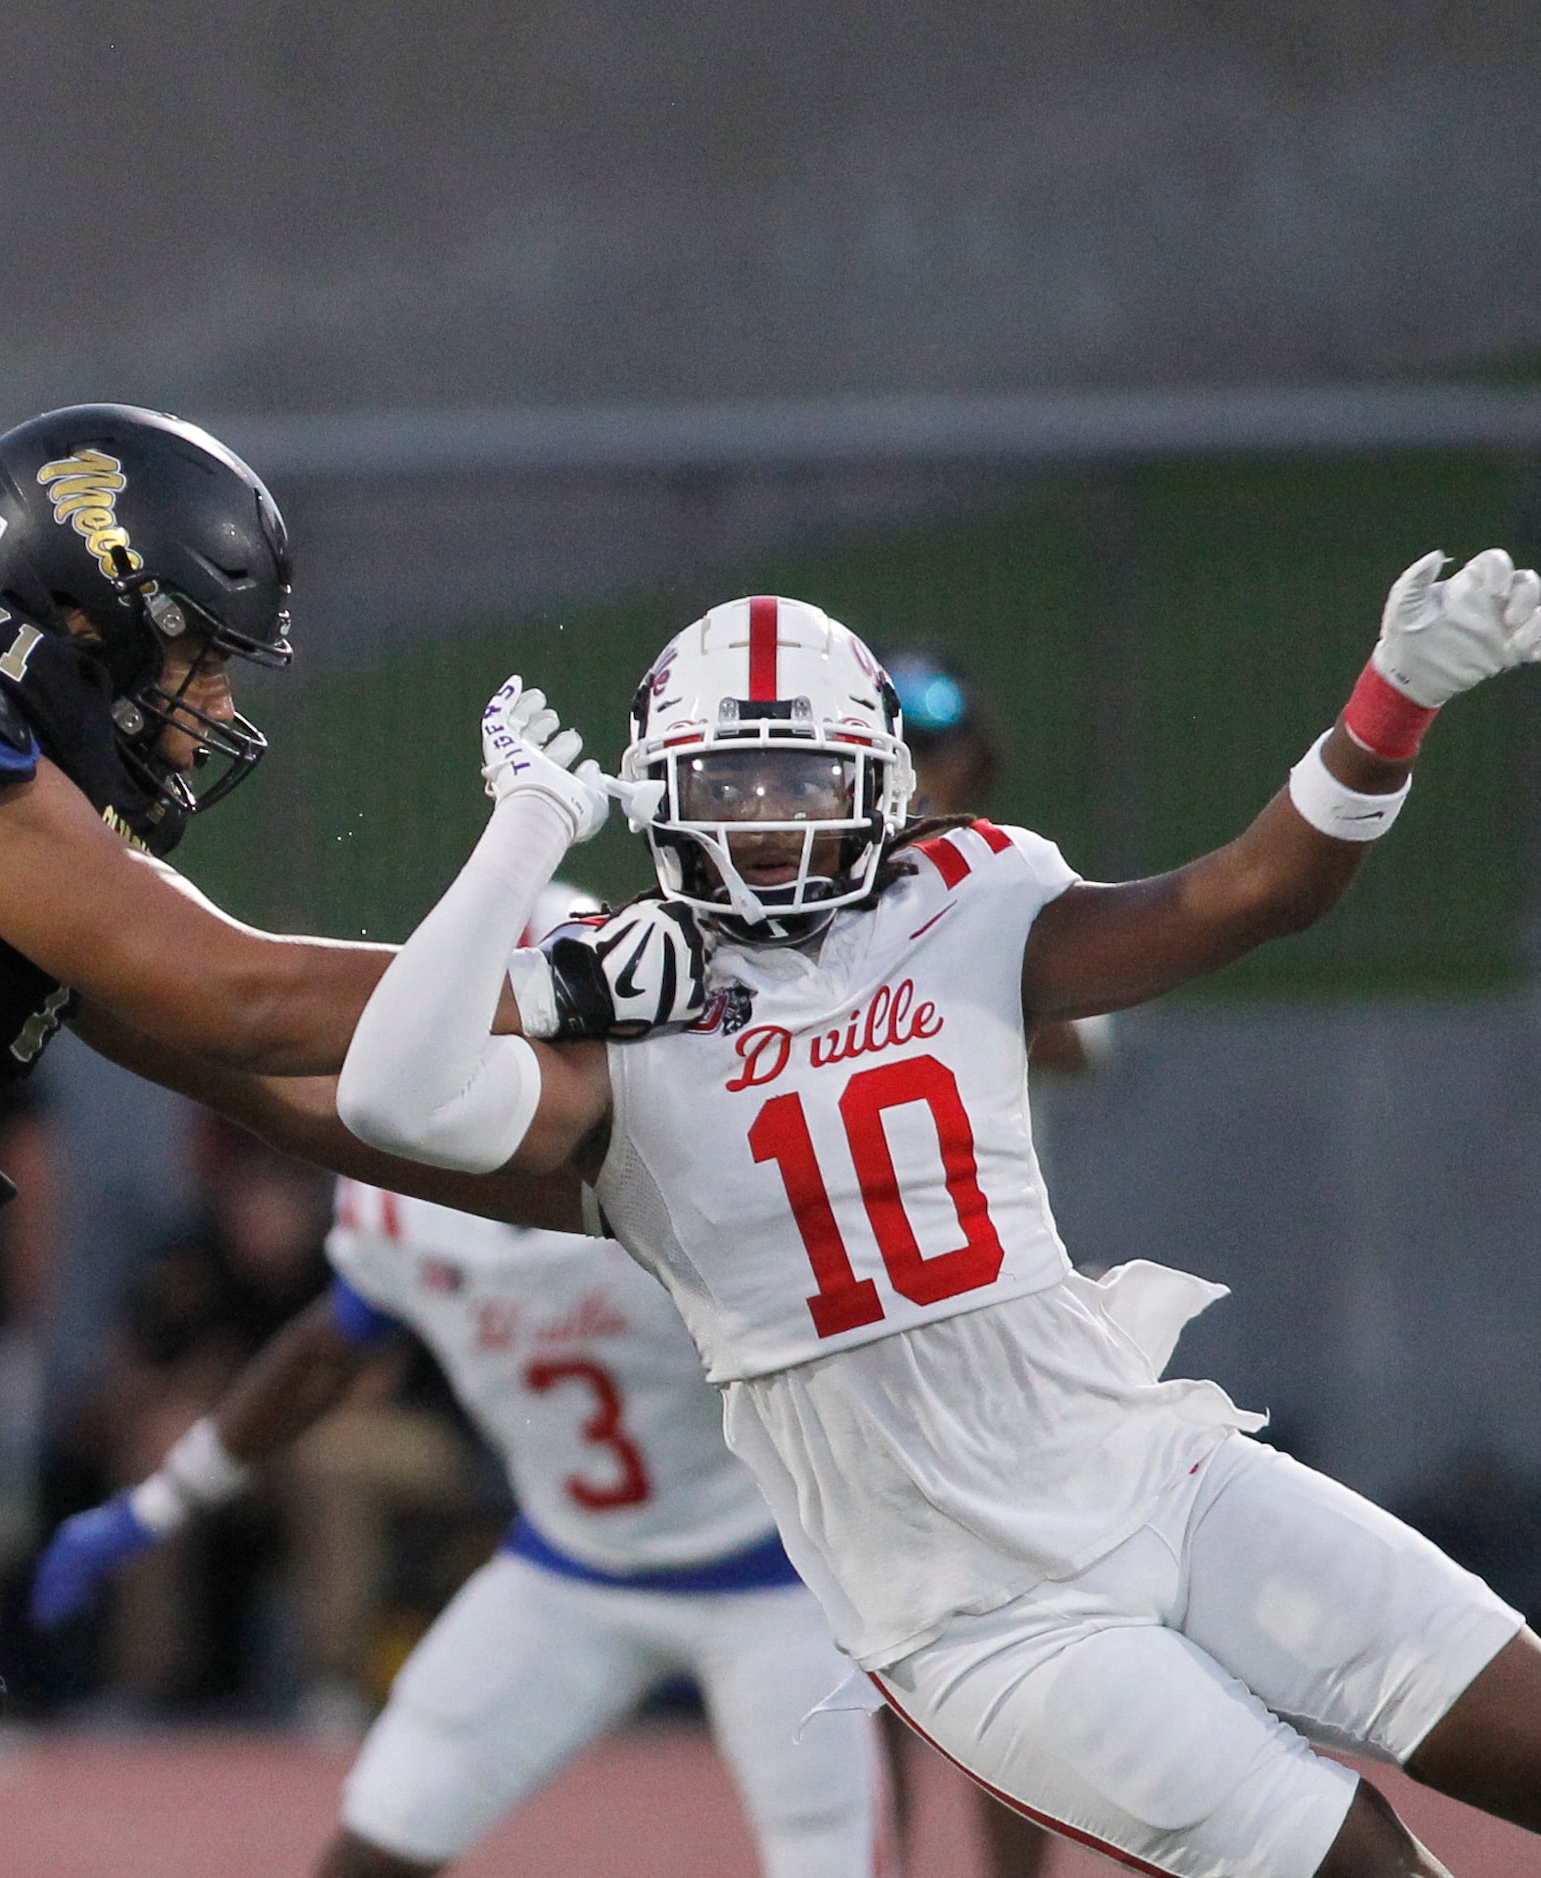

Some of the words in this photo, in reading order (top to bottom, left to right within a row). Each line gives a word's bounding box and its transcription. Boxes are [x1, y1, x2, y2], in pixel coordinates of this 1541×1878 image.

[726, 1025, 792, 1092] D
[810, 978, 944, 1068] ville
[747, 1054, 1005, 1340] 10
[522, 1355, 653, 1513] 3
